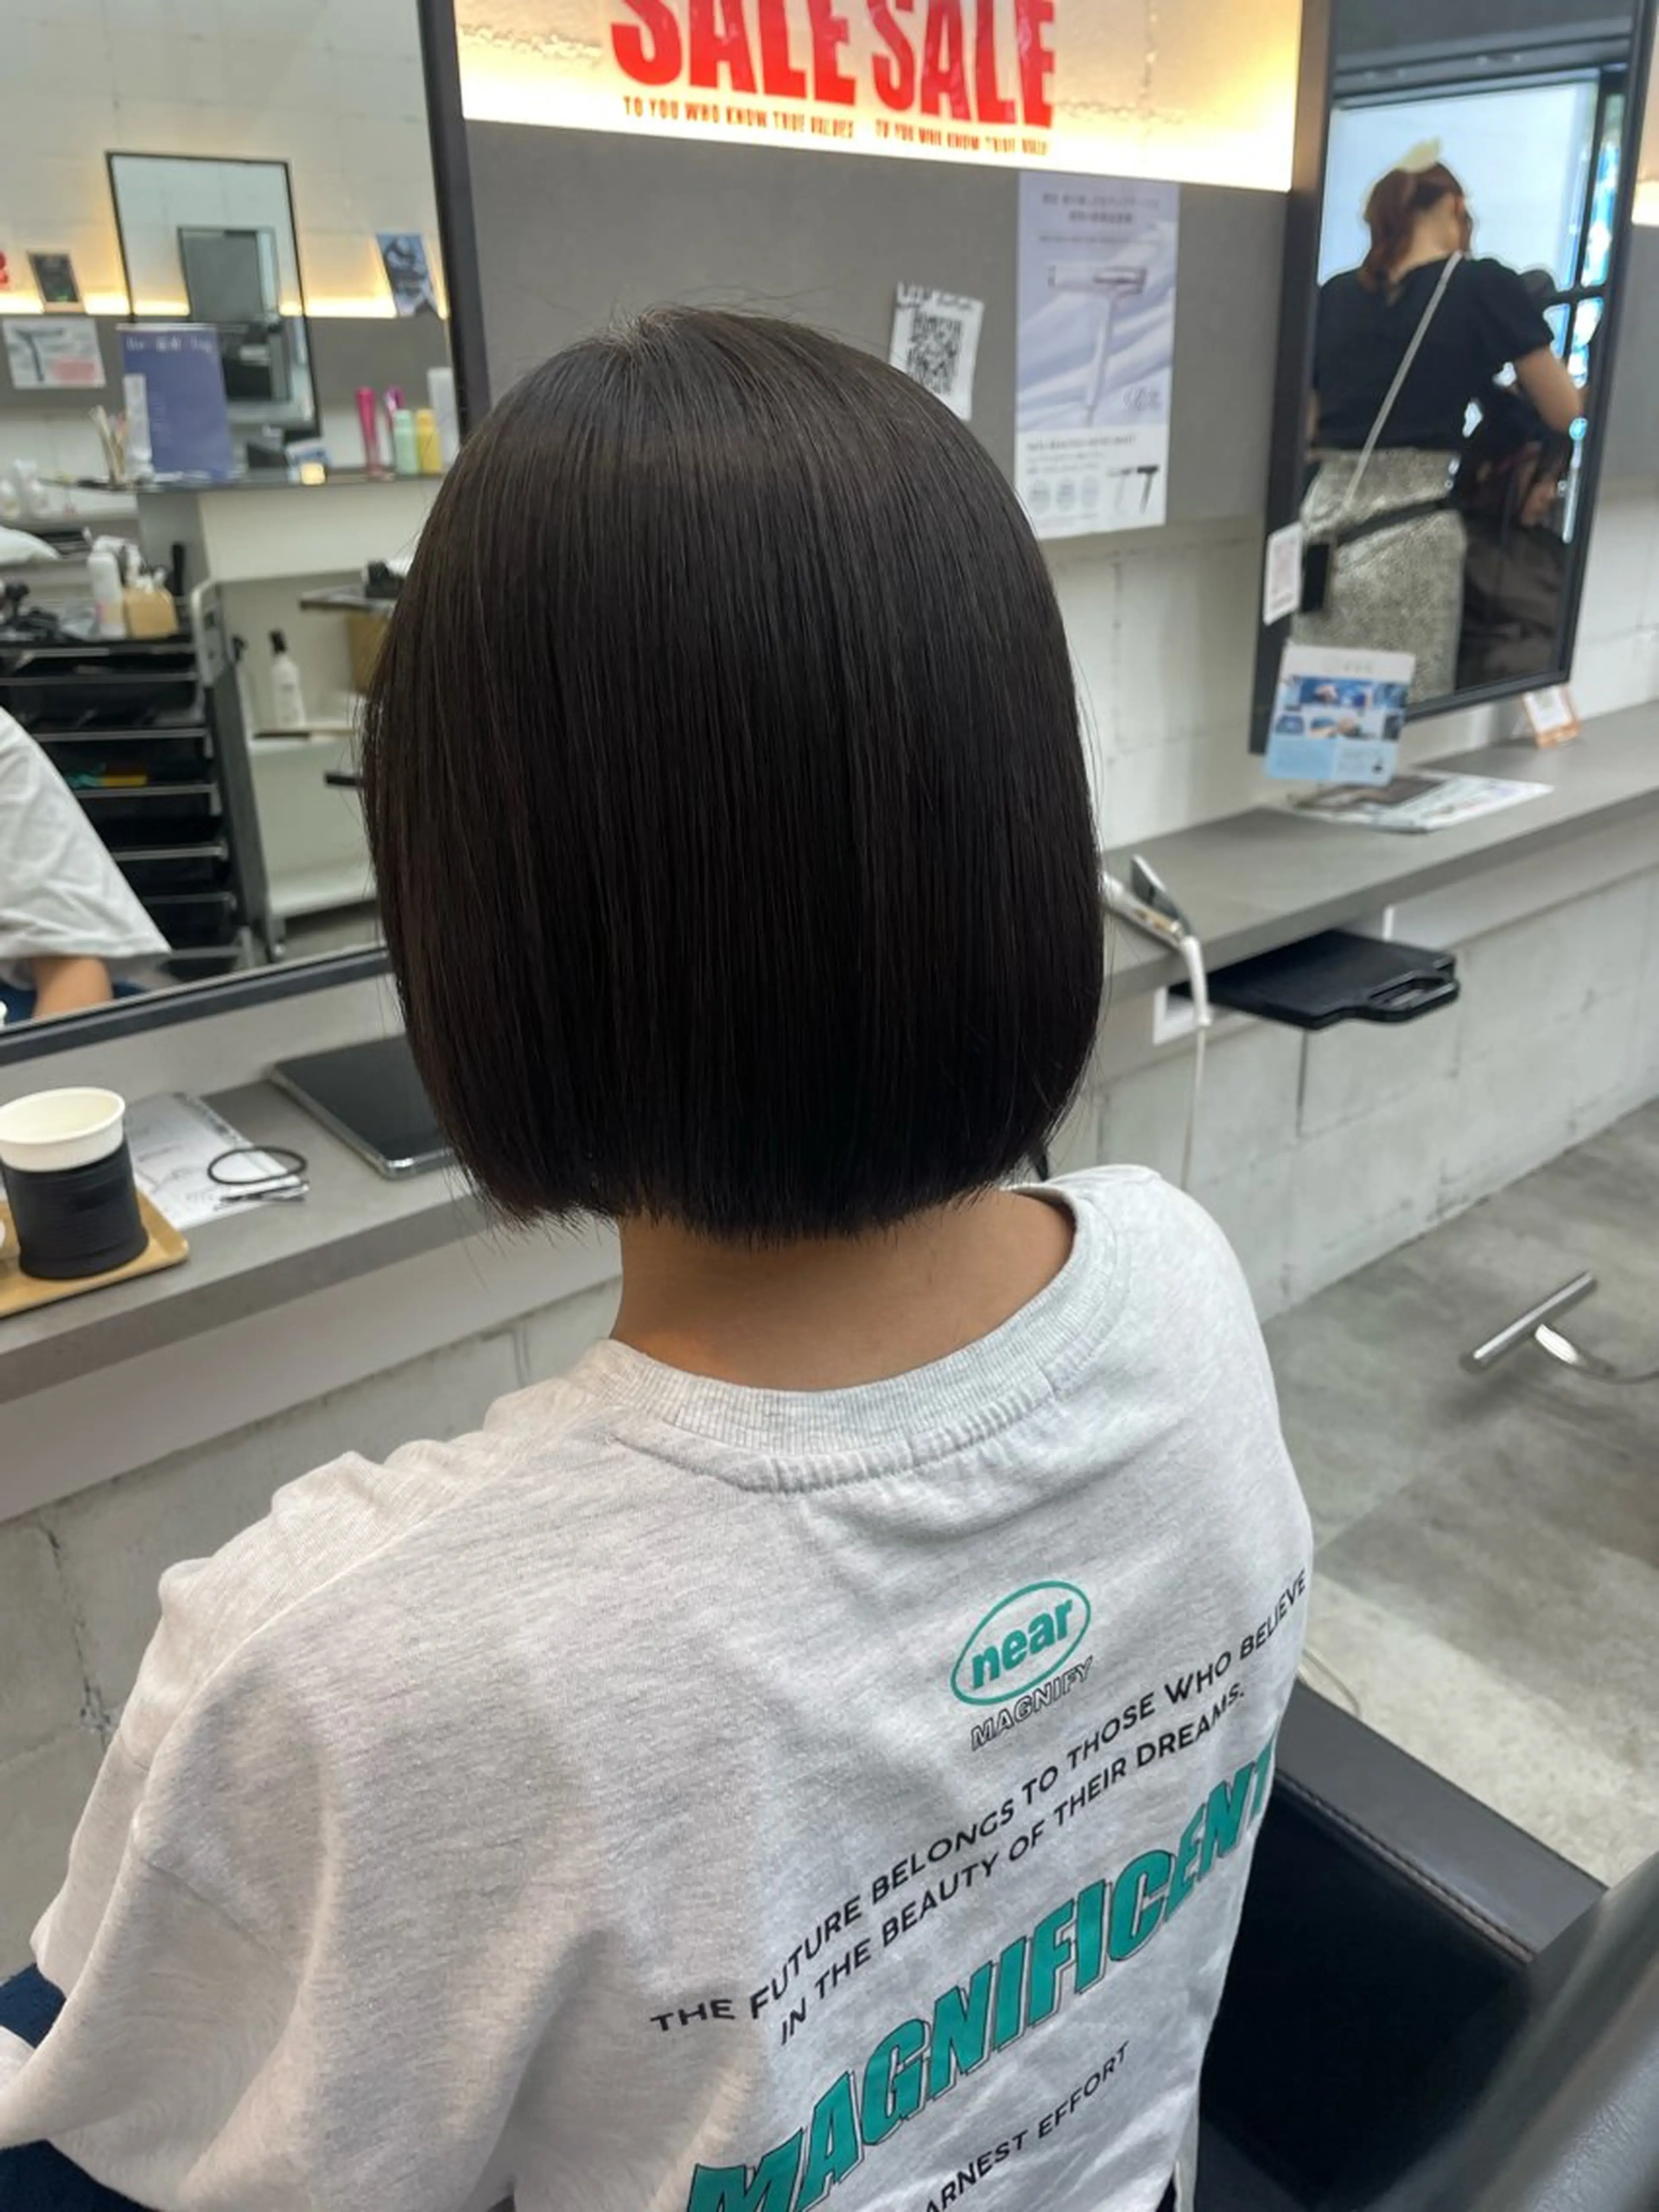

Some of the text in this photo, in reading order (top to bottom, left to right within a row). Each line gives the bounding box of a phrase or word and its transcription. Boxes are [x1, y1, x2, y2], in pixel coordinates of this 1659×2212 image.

[611, 0, 856, 105] SALE
[868, 0, 1054, 128] SALE
[623, 96, 642, 117] TO
[649, 98, 677, 120] YOU
[972, 1599, 1073, 1690] near
[970, 1654, 1093, 1752] MAGNIFY
[650, 1569, 1306, 2031] THE FUTURE BELONGS TO THOSE WHO BELIEVE
[781, 1682, 1244, 2046] IN THE BEAUTY OF THEIR DREAMS.
[1039, 2041, 1129, 2139] EFFORT
